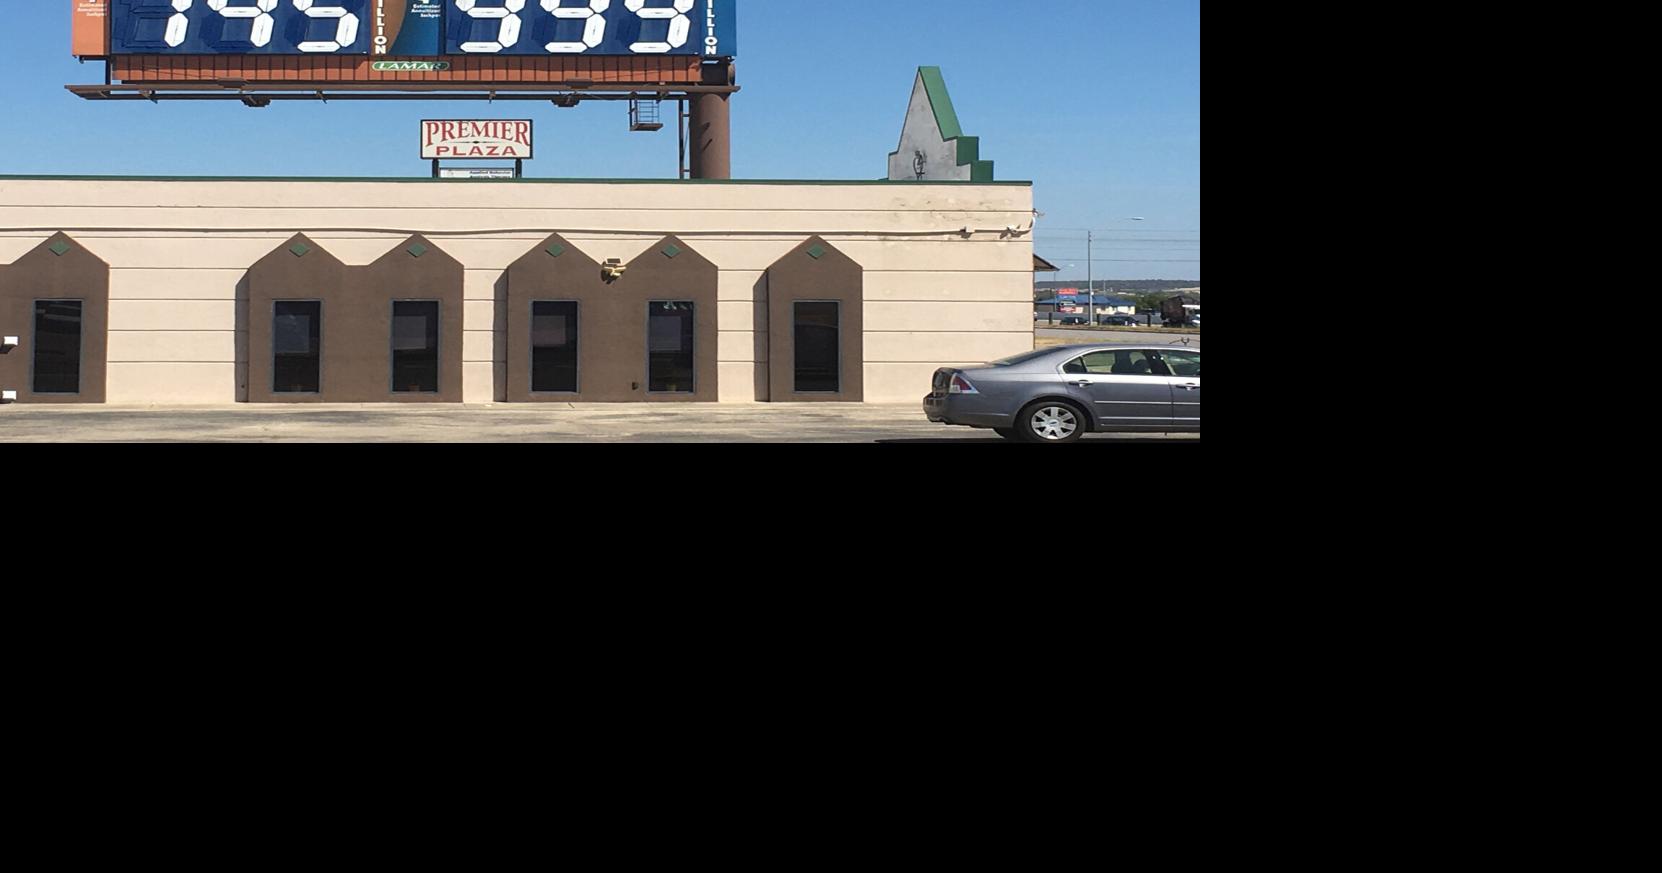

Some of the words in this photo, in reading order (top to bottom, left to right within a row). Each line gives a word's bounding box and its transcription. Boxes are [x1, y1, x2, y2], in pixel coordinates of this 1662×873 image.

[379, 62, 441, 70] LAMAR
[425, 121, 530, 147] PREMIER
[436, 146, 517, 156] PLAZA
